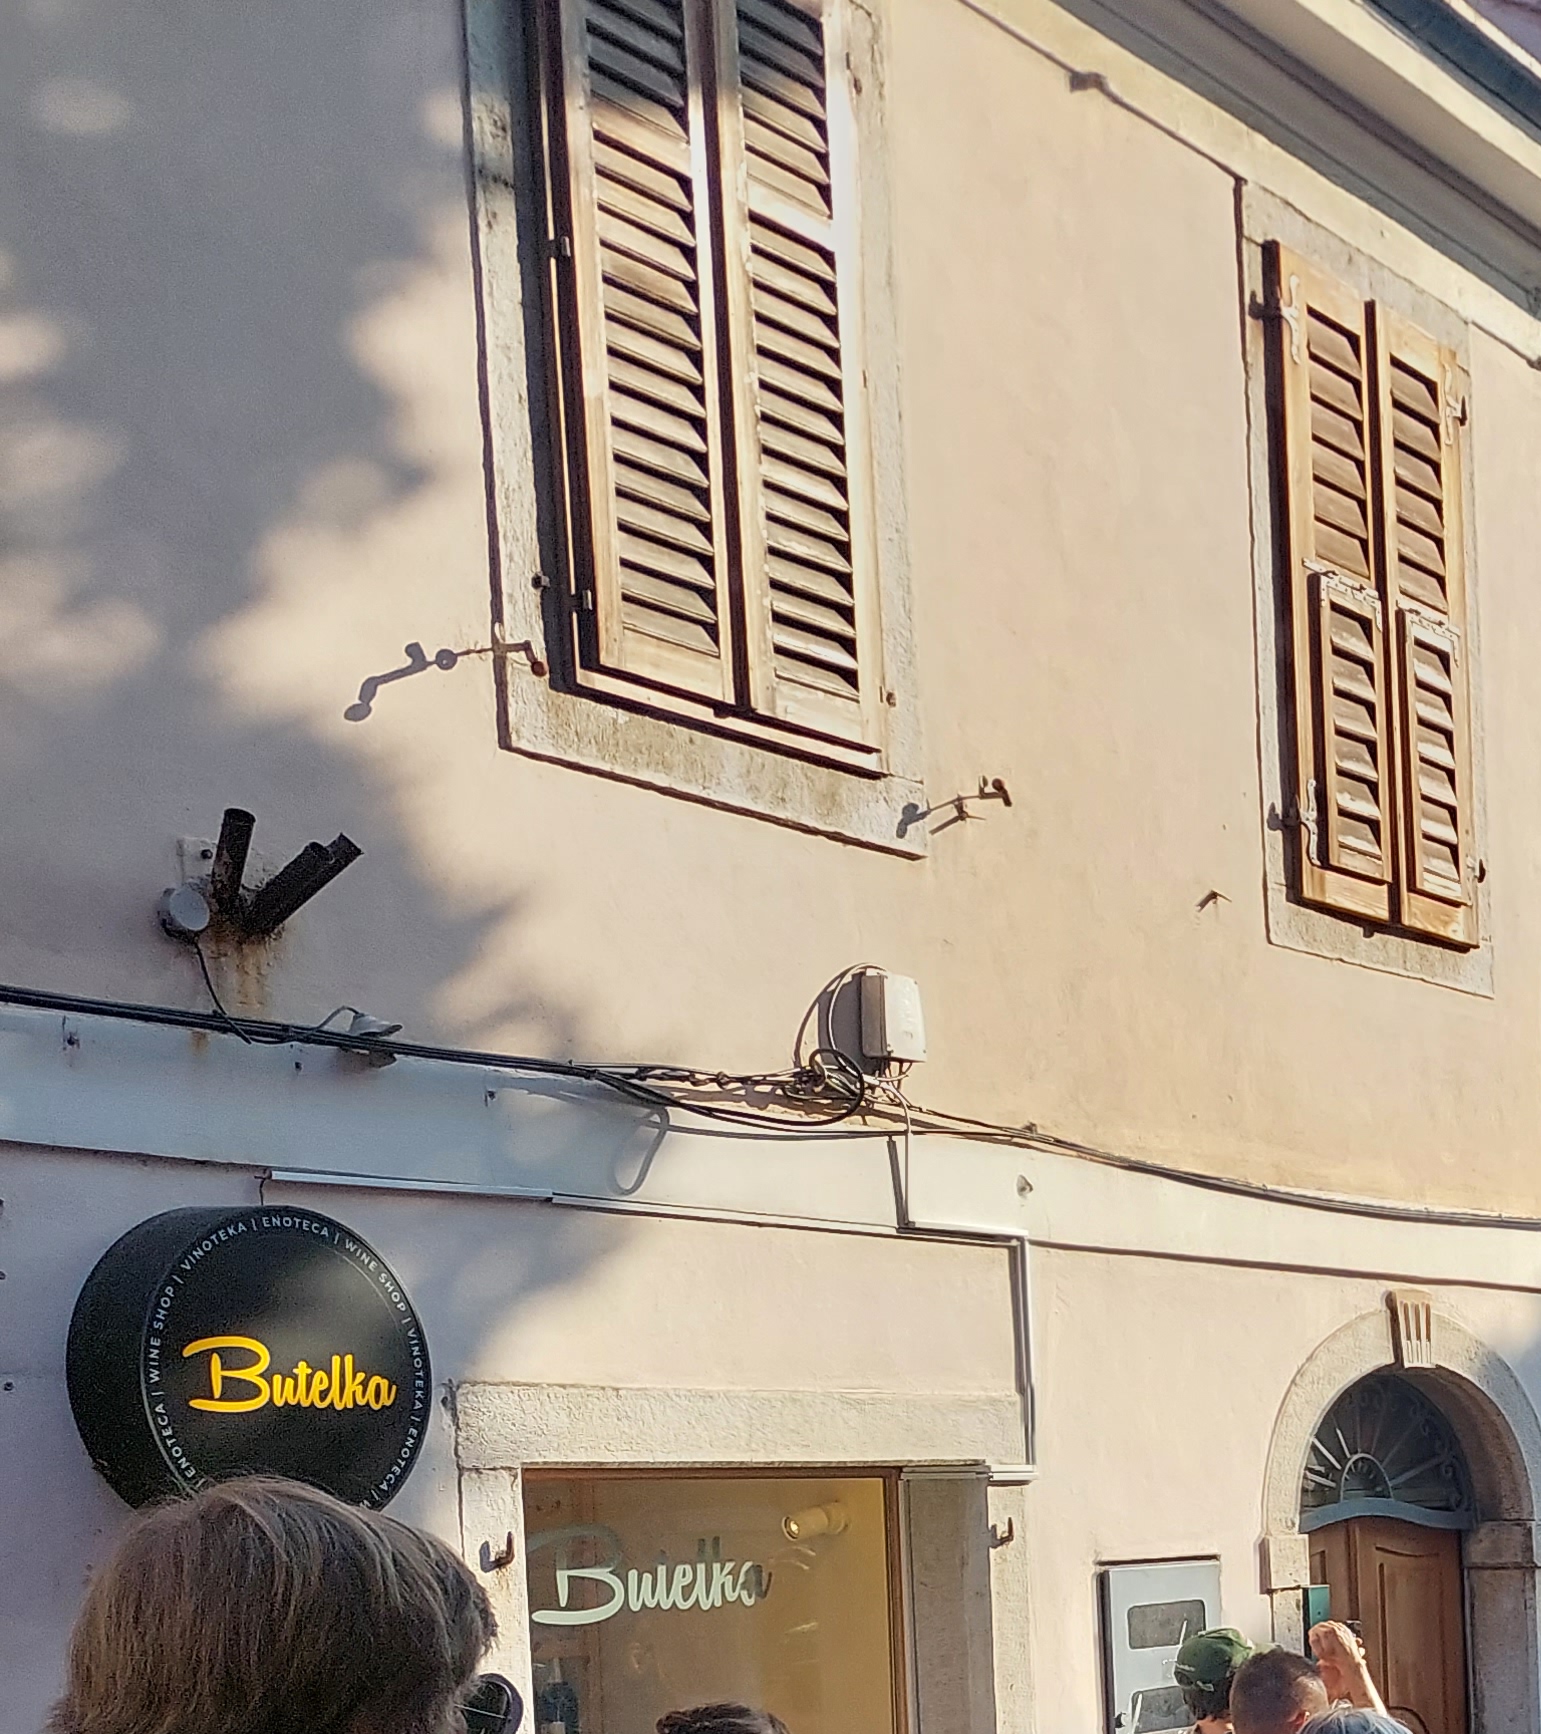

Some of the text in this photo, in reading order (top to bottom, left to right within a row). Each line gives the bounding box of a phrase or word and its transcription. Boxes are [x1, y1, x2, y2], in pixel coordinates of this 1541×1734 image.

[149, 1216, 425, 1491] ENOTECA WINE SHOP VINOTEKA ENOTECA WINE SHOP VINOTEKA ENOTECA
[182, 1336, 397, 1413] Butelka
[526, 1524, 772, 1625] Butelka
